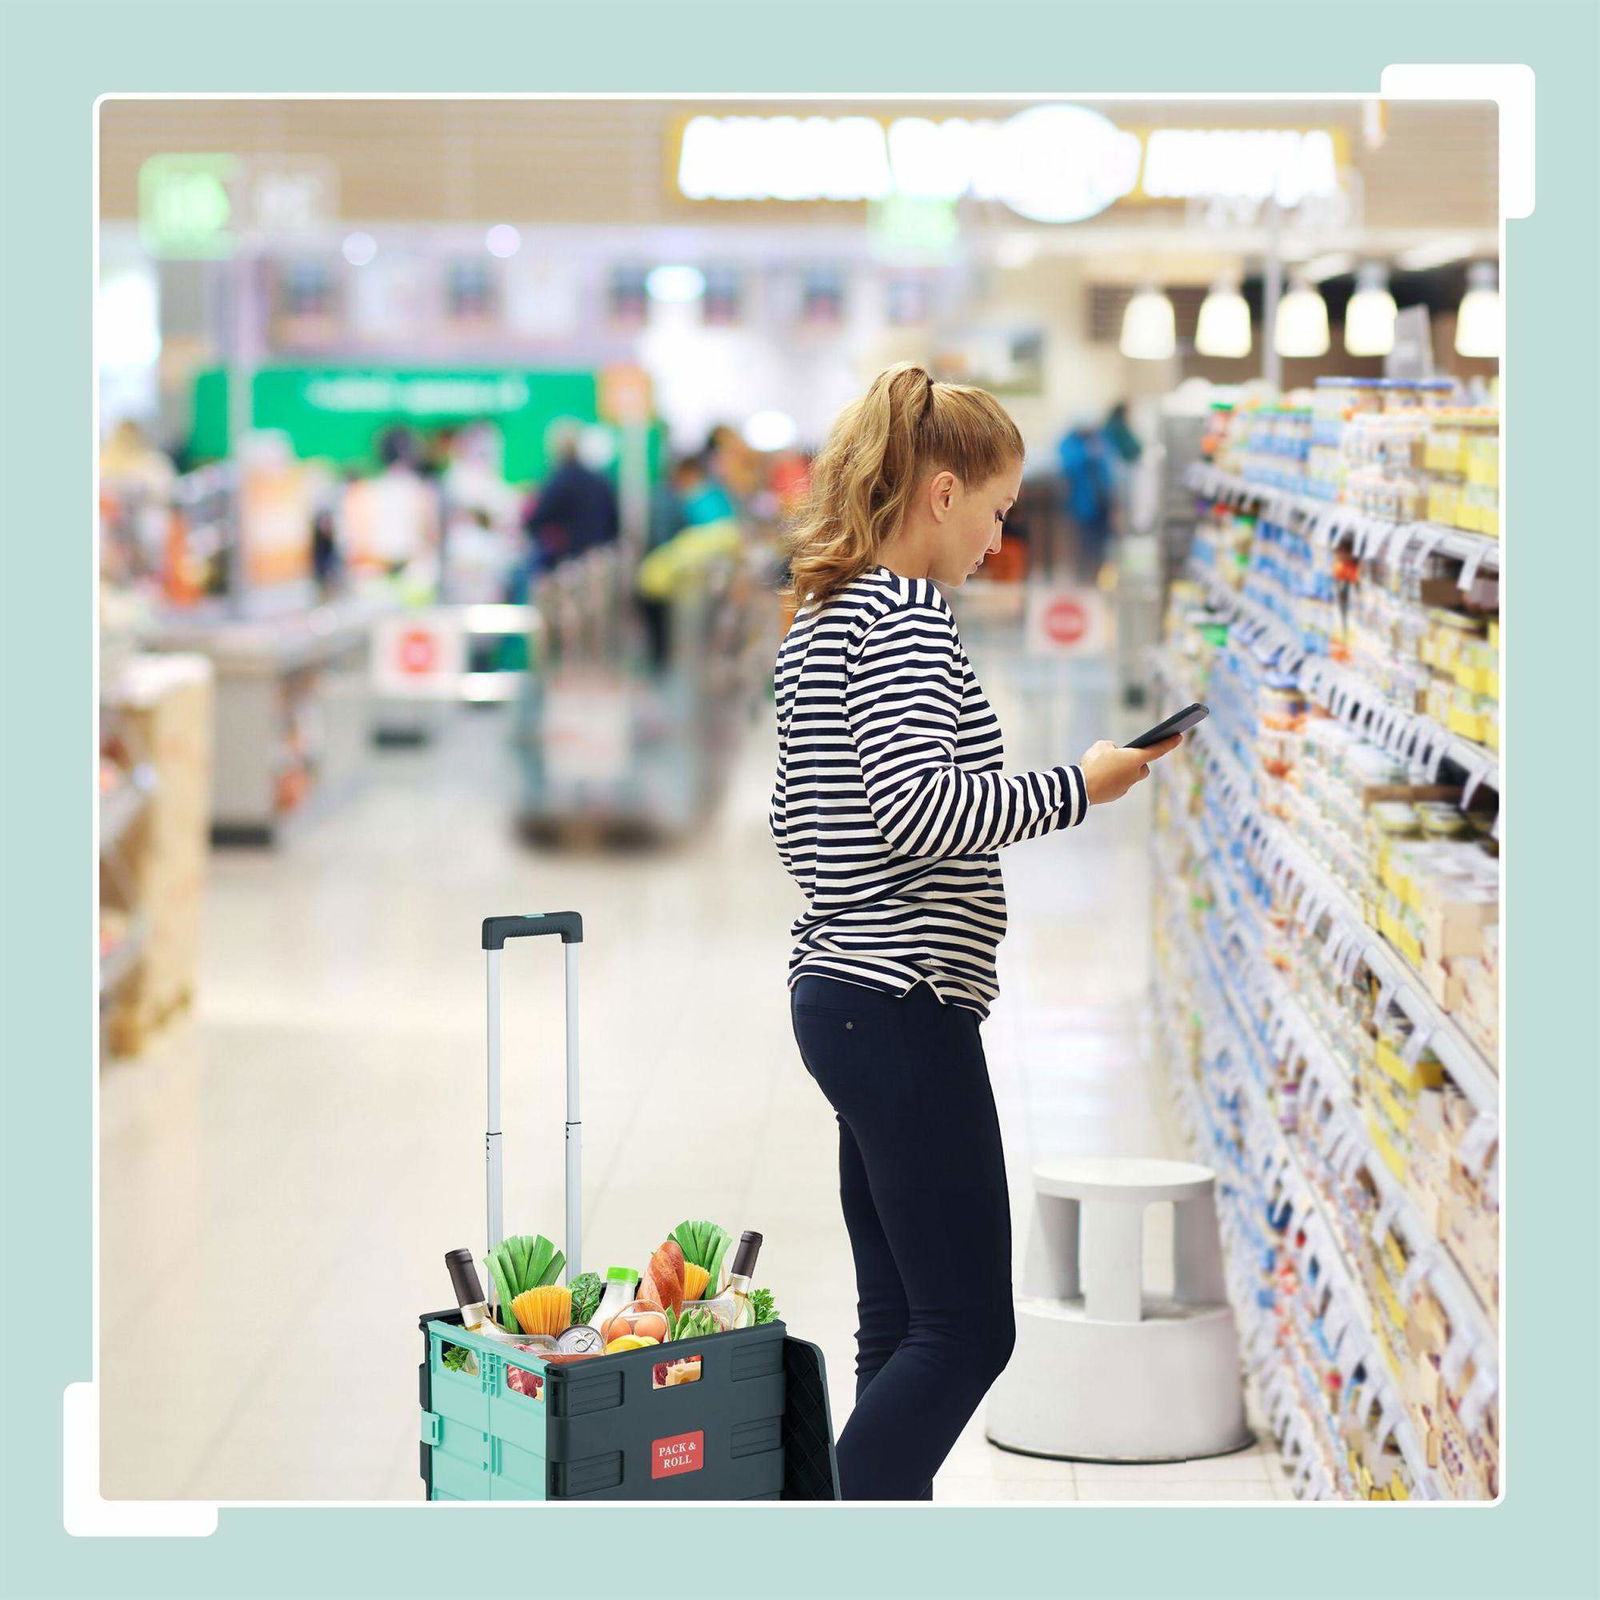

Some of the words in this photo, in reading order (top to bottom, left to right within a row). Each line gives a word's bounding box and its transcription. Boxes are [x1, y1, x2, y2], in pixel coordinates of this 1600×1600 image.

[659, 1442, 686, 1456] PACK
[688, 1441, 696, 1450] &
[664, 1454, 692, 1468] ROLL
